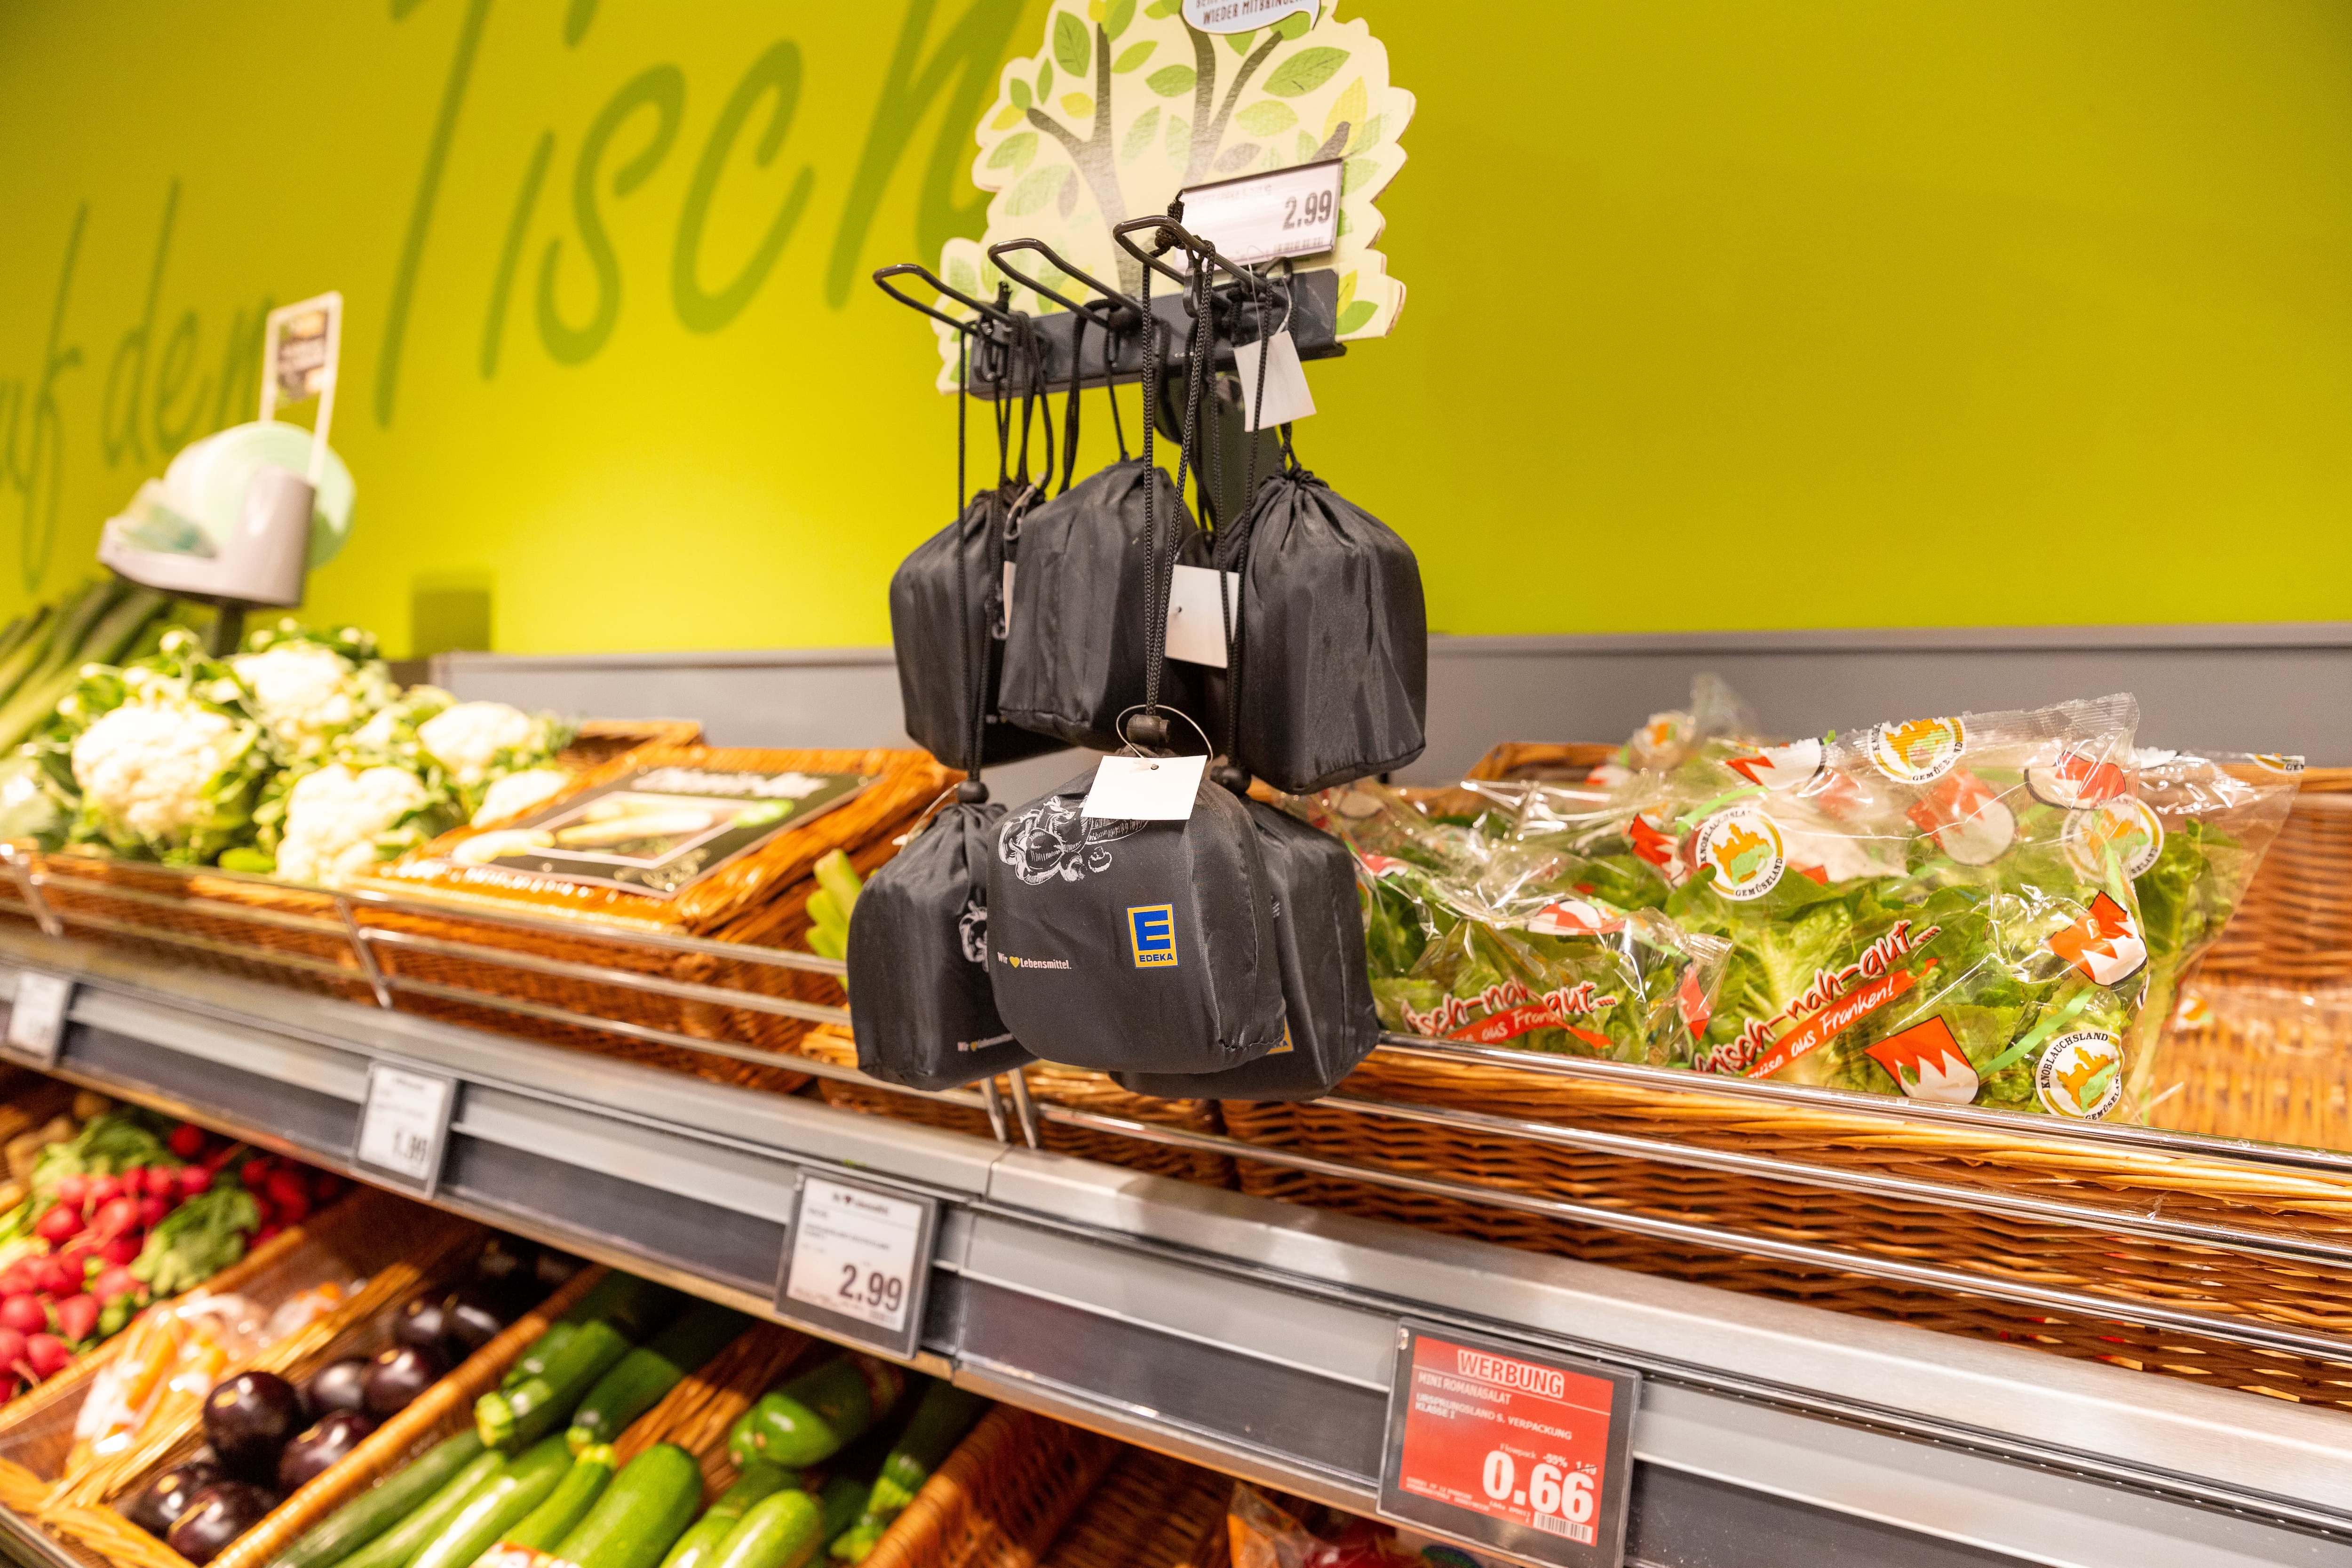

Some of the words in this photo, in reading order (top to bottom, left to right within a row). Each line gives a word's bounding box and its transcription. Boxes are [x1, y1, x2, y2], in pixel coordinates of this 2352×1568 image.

[1203, 3, 1239, 25] WIEDER
[1283, 190, 1332, 231] 2.99
[1735, 858, 1783, 897] GEMÜSELAND
[997, 952, 1008, 964] Wir
[1019, 958, 1072, 970] Lebensmittel.
[1139, 953, 1174, 962] EDEKA
[1481, 1020, 1509, 1041] aus
[1790, 1030, 1817, 1058] aus
[1819, 976, 1894, 1036] Franken!
[2041, 1032, 2108, 1089] KNOBLAUCHSLAND
[839, 1263, 903, 1312] 2.99
[1418, 1371, 1442, 1388] MINI
[1443, 1377, 1512, 1405] ROMANASALAT
[1457, 1349, 1565, 1399] WERBUNG
[1415, 1401, 1448, 1418] KLASSE
[1508, 1415, 1573, 1441] VERPACKUNG
[1482, 1449, 1595, 1523] 0.66
